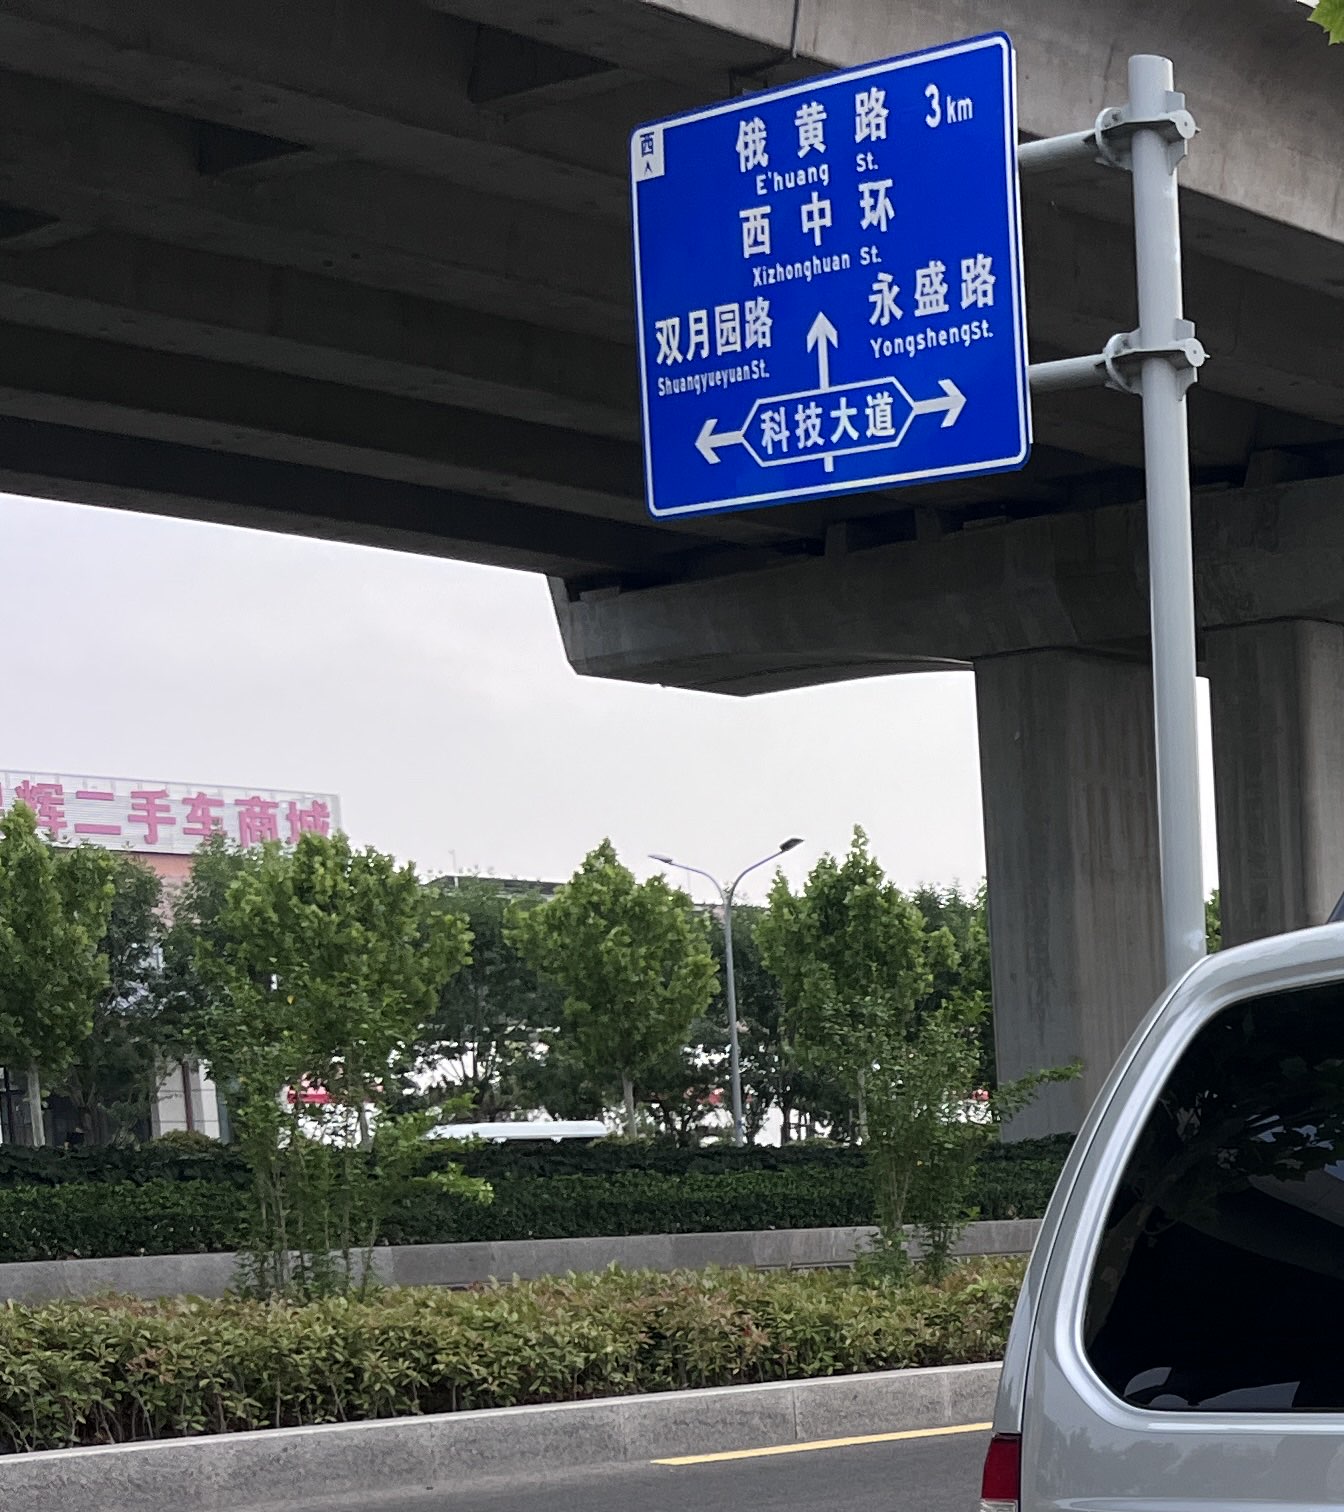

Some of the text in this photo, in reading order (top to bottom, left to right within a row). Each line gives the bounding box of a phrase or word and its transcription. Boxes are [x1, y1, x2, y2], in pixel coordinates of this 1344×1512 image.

[640, 131, 655, 157] 西
[736, 86, 889, 172] 俄黄路
[756, 152, 879, 195] E'huang St.
[739, 178, 895, 259] 西中环
[752, 245, 882, 287] Xizhonghuan St.
[869, 253, 996, 327] 永盛路
[655, 296, 773, 366] 双月园路
[761, 391, 896, 455] 科技大道
[0, 779, 331, 848] 辉二手车商城
